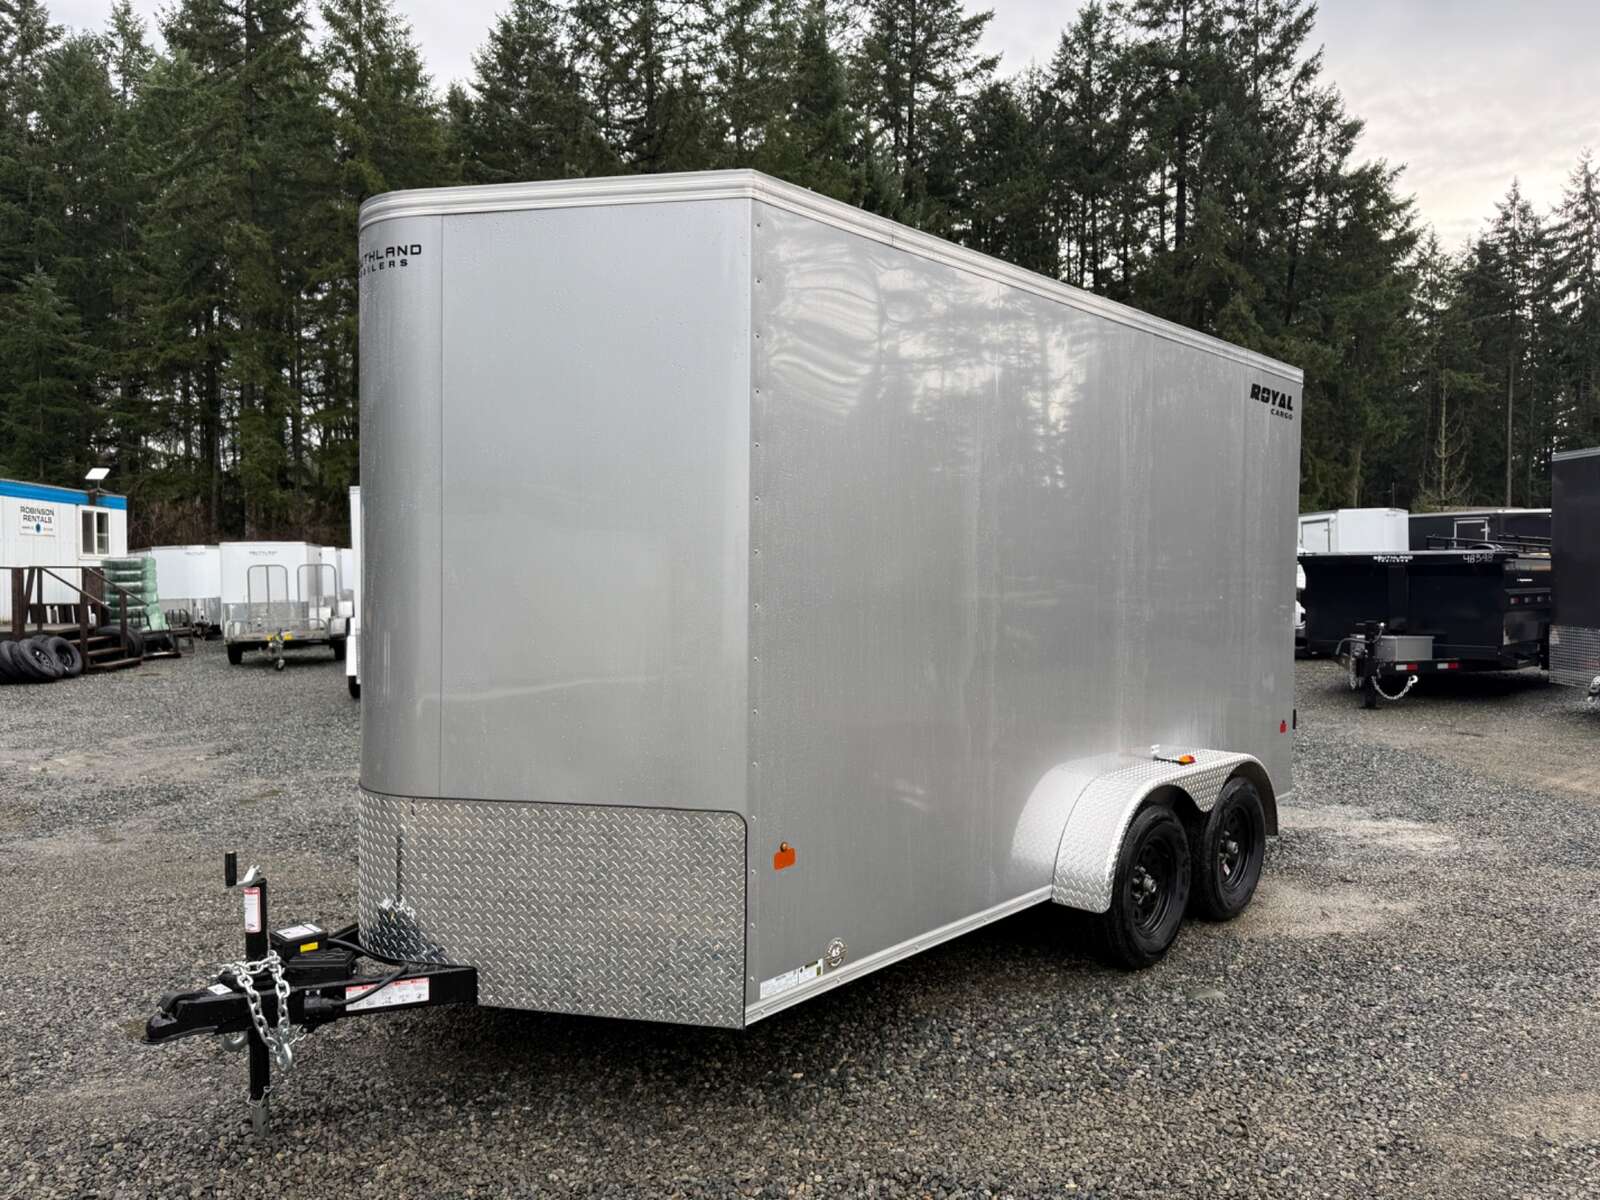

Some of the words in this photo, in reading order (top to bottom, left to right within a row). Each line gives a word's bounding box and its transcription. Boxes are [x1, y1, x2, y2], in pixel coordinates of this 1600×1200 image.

[1250, 383, 1294, 411] ROYAL
[1270, 408, 1293, 420] CARGO
[20, 506, 55, 516] ROBINSON
[23, 514, 53, 524] RENTALS
